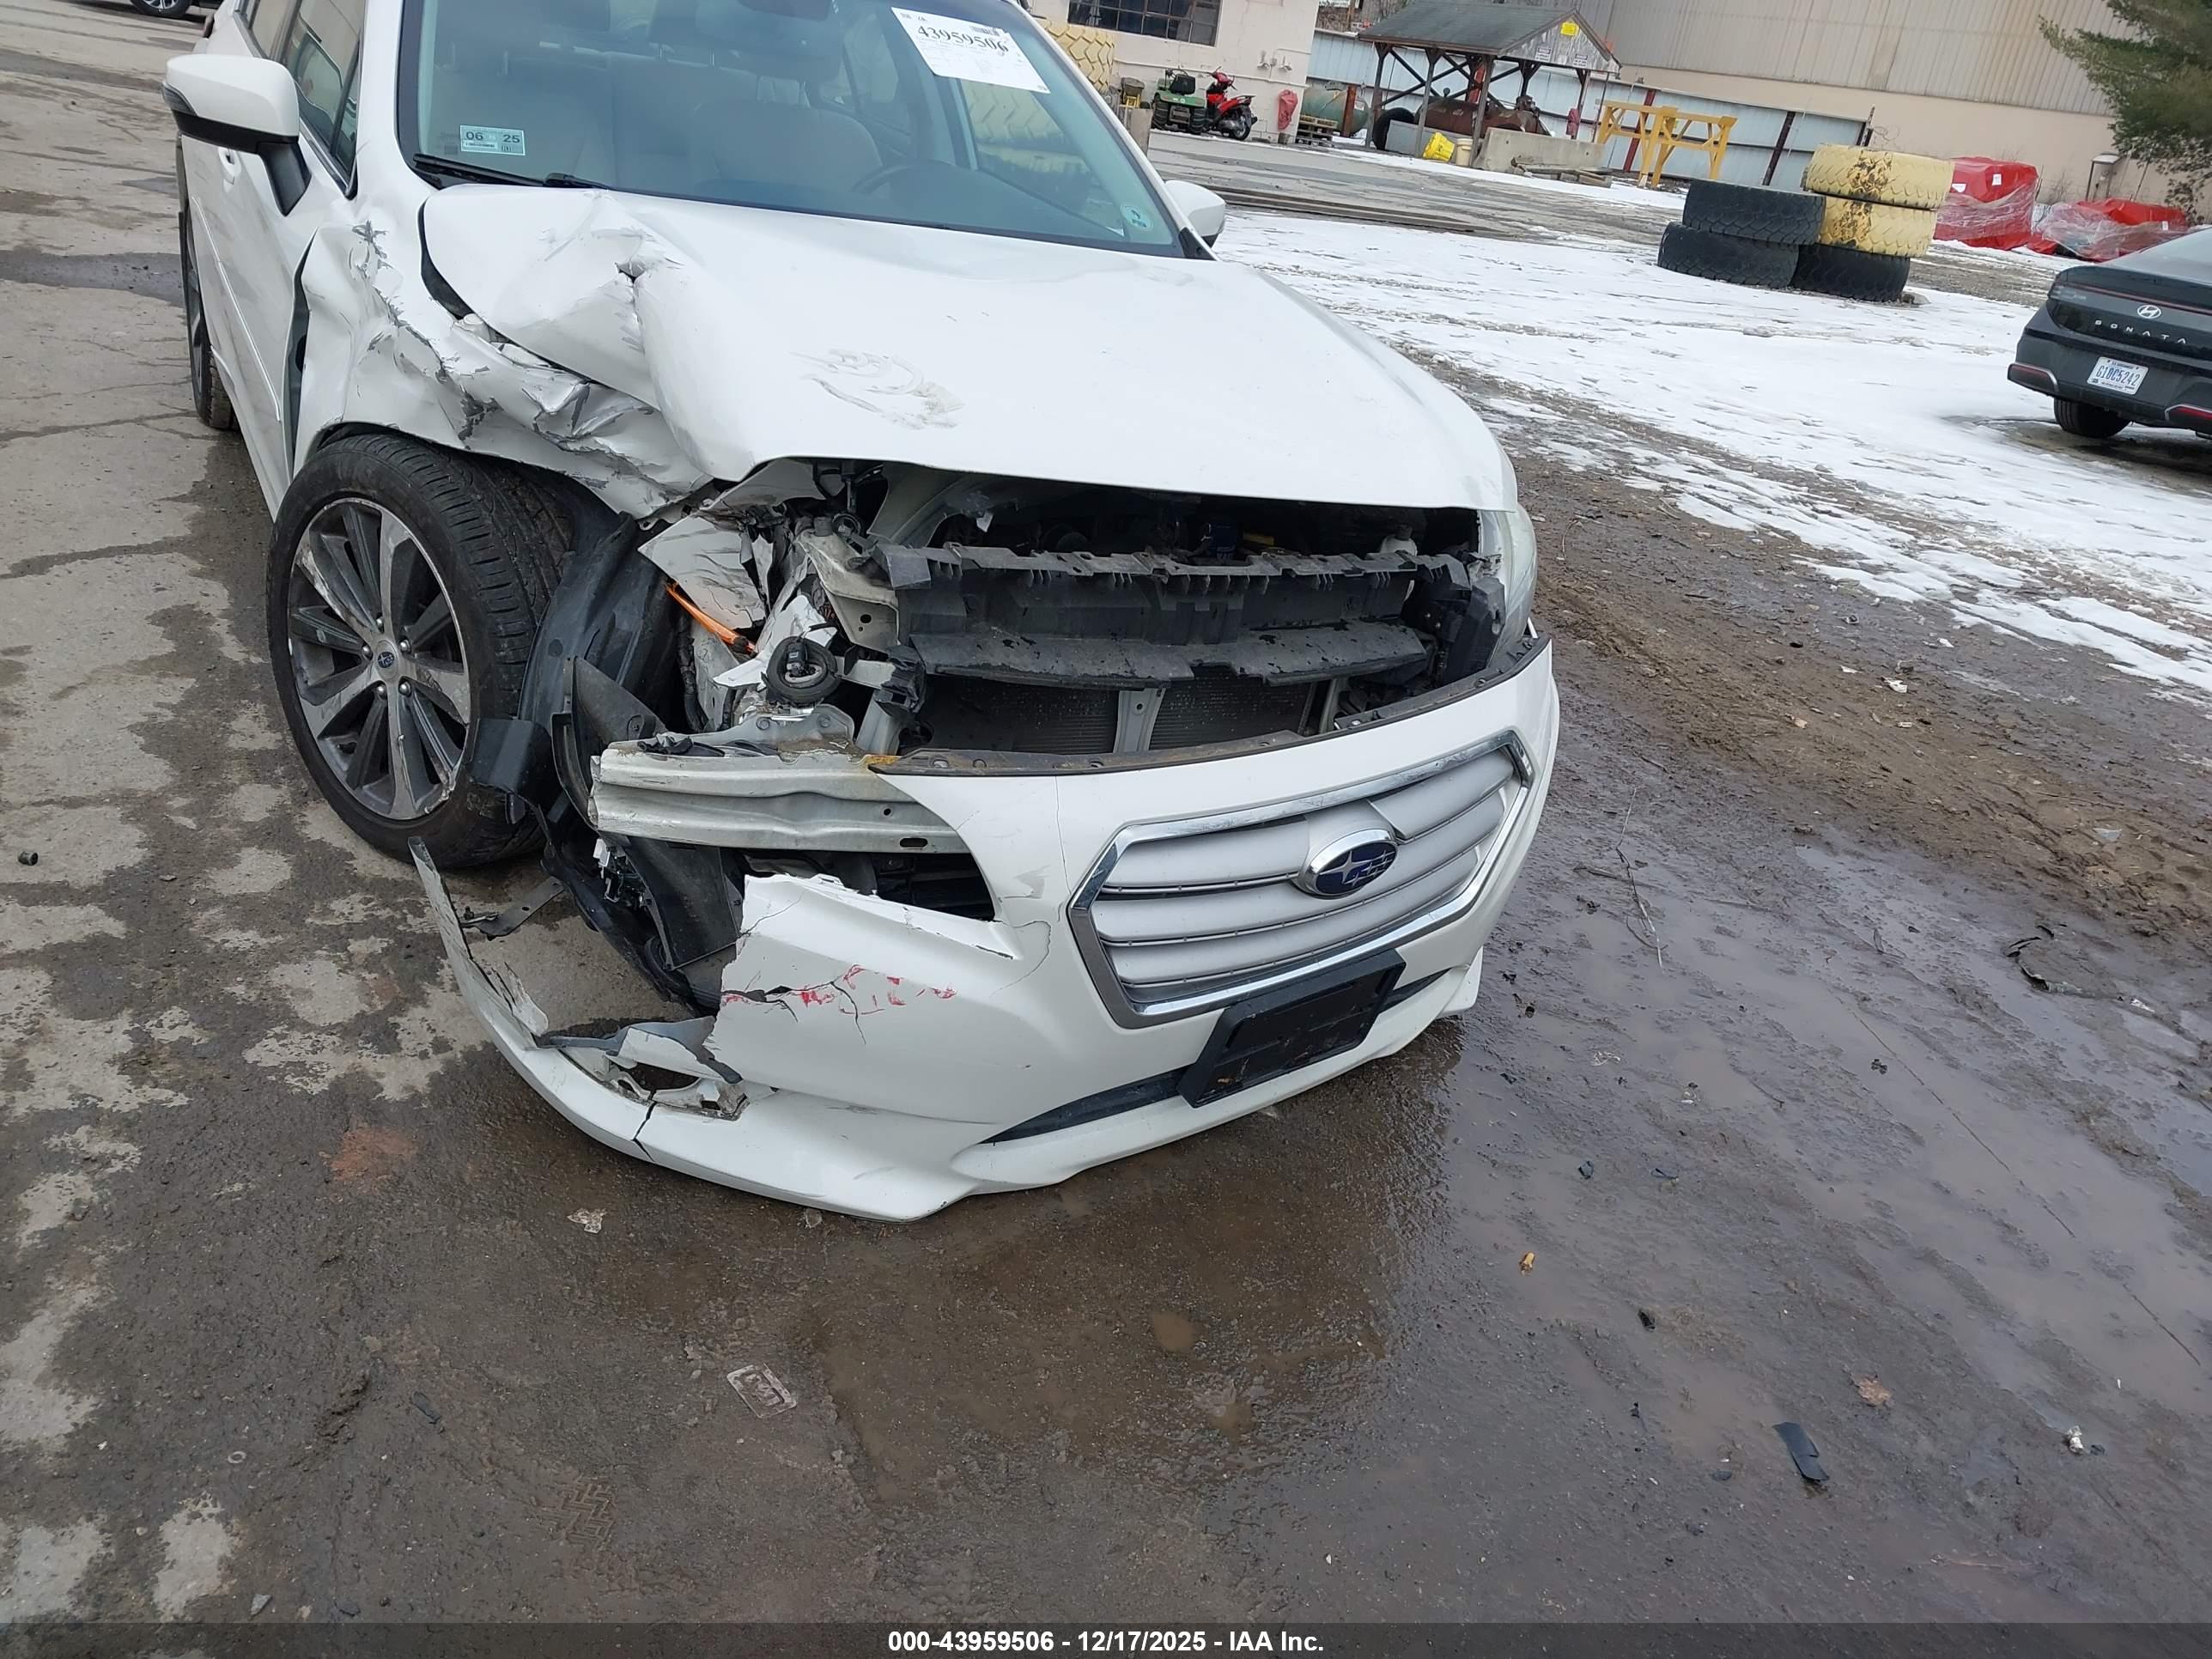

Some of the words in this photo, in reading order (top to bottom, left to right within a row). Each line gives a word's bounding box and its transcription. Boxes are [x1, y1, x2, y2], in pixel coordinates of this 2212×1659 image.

[917, 25, 1010, 53] 43959506
[465, 131, 483, 141] 06
[502, 133, 520, 143] 25
[2094, 319, 2188, 344] SONATA
